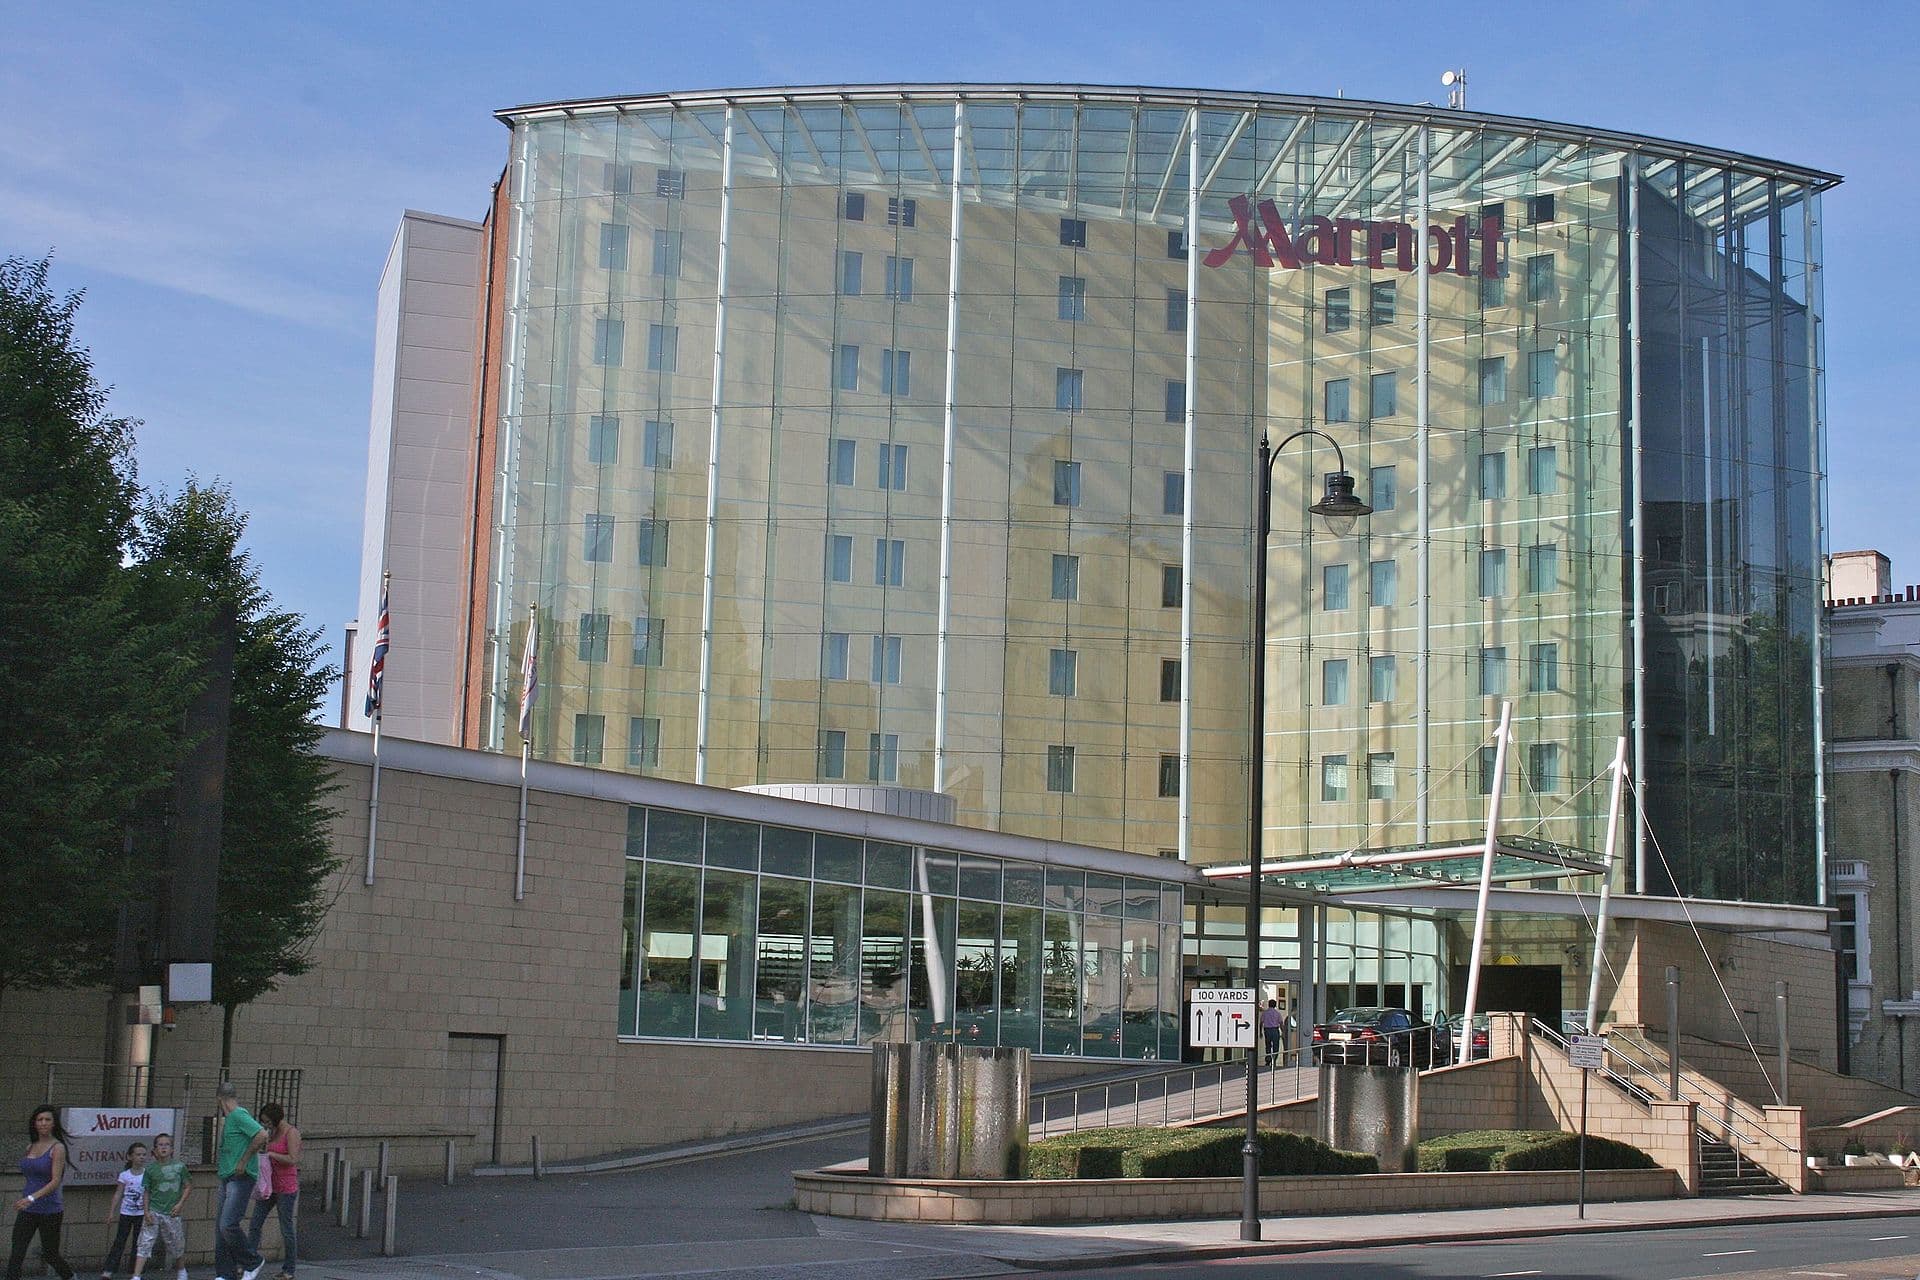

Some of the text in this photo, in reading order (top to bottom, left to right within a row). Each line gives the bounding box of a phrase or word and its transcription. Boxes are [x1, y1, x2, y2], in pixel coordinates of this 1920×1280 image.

[1203, 194, 1503, 279] Marriott
[1198, 991, 1249, 1000] 100 YARDS
[91, 1113, 151, 1132] Marriott
